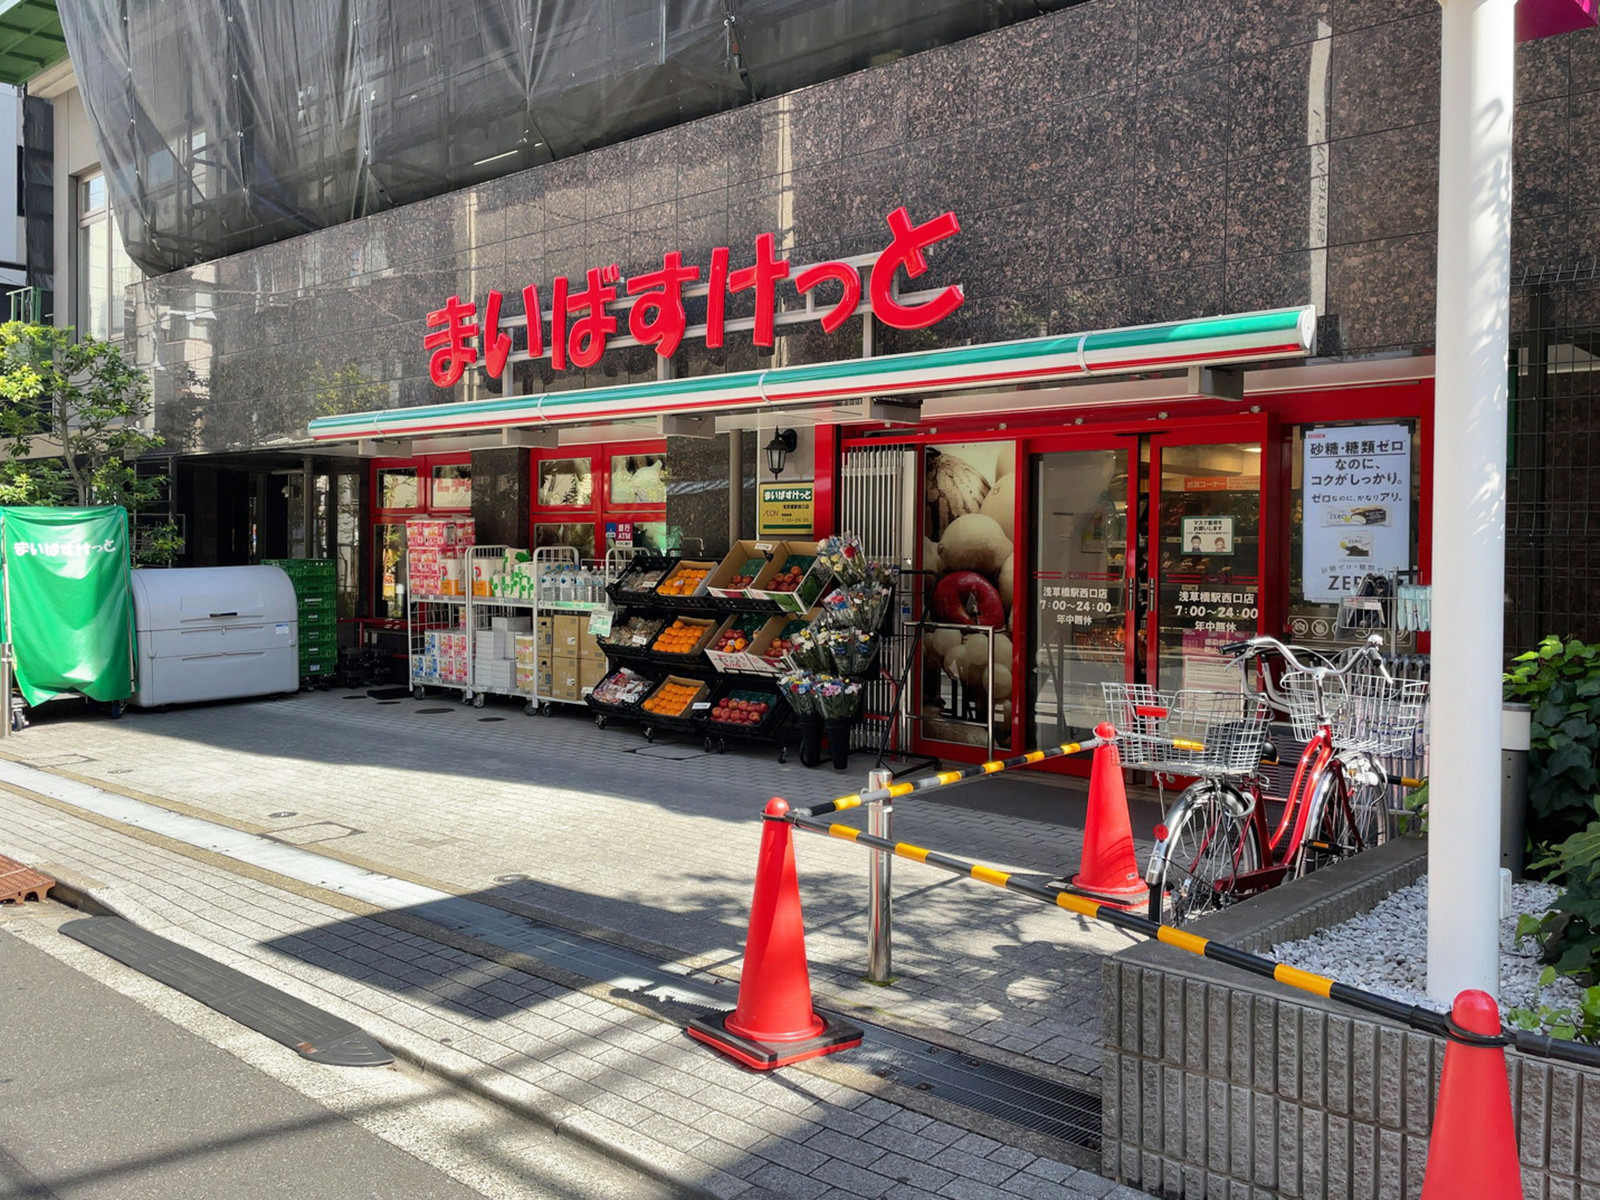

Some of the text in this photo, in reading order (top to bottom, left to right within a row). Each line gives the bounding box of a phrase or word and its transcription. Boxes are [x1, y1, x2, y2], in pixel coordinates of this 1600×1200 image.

[424, 206, 965, 388] まいばすけっと
[1310, 440, 1404, 456] 砂糖・糖類ゼロ
[1335, 458, 1381, 471] なのに、
[1311, 472, 1403, 486] コクがしっかり。
[764, 490, 811, 500] まいばすけっと
[1311, 492, 1403, 504] ゼロなのに、かなりアリ。
[14, 539, 116, 556] まいばすけっと
[1043, 586, 1108, 599] 浅草橋駅西口店
[1178, 591, 1255, 604] 浅草橋駅西口店
[1057, 614, 1093, 625] 年中無休
[1194, 621, 1237, 633] 年中無休
